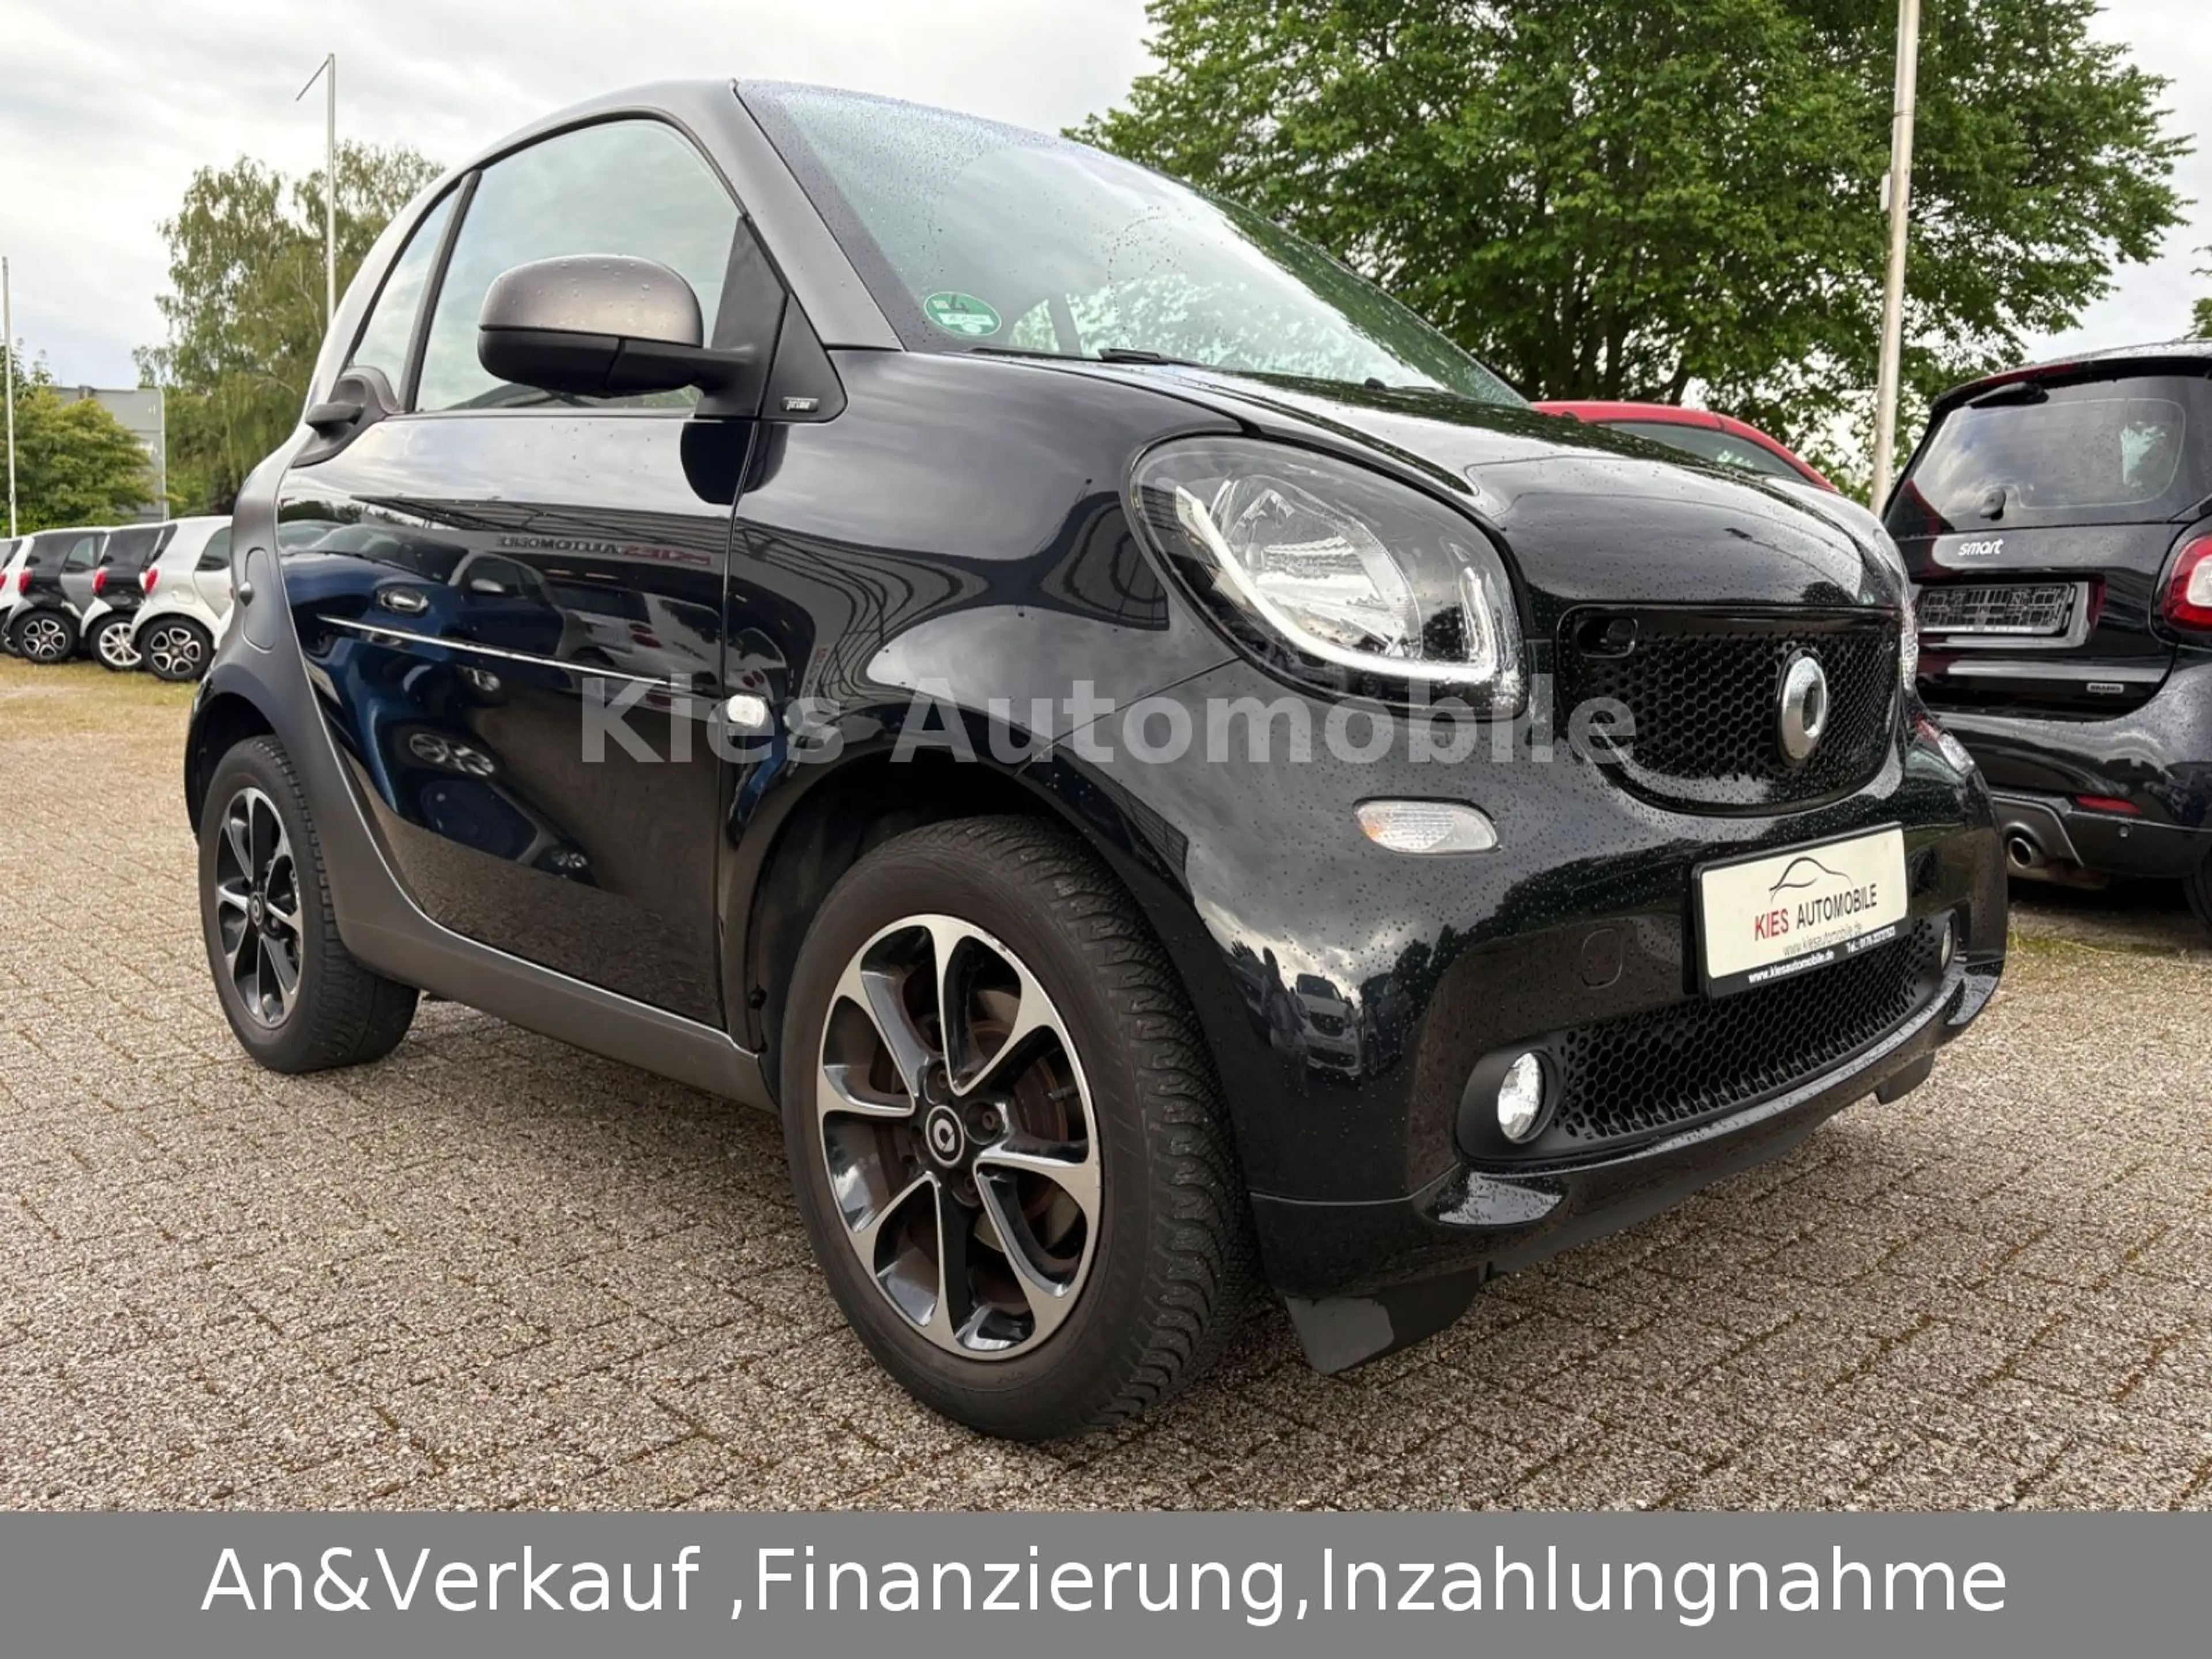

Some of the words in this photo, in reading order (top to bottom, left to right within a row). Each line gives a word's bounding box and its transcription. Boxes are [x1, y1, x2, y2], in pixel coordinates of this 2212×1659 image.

[1958, 538, 2004, 555] smart
[1755, 908, 1789, 941] KIES
[1797, 883, 1877, 929] AUTOMOBILE
